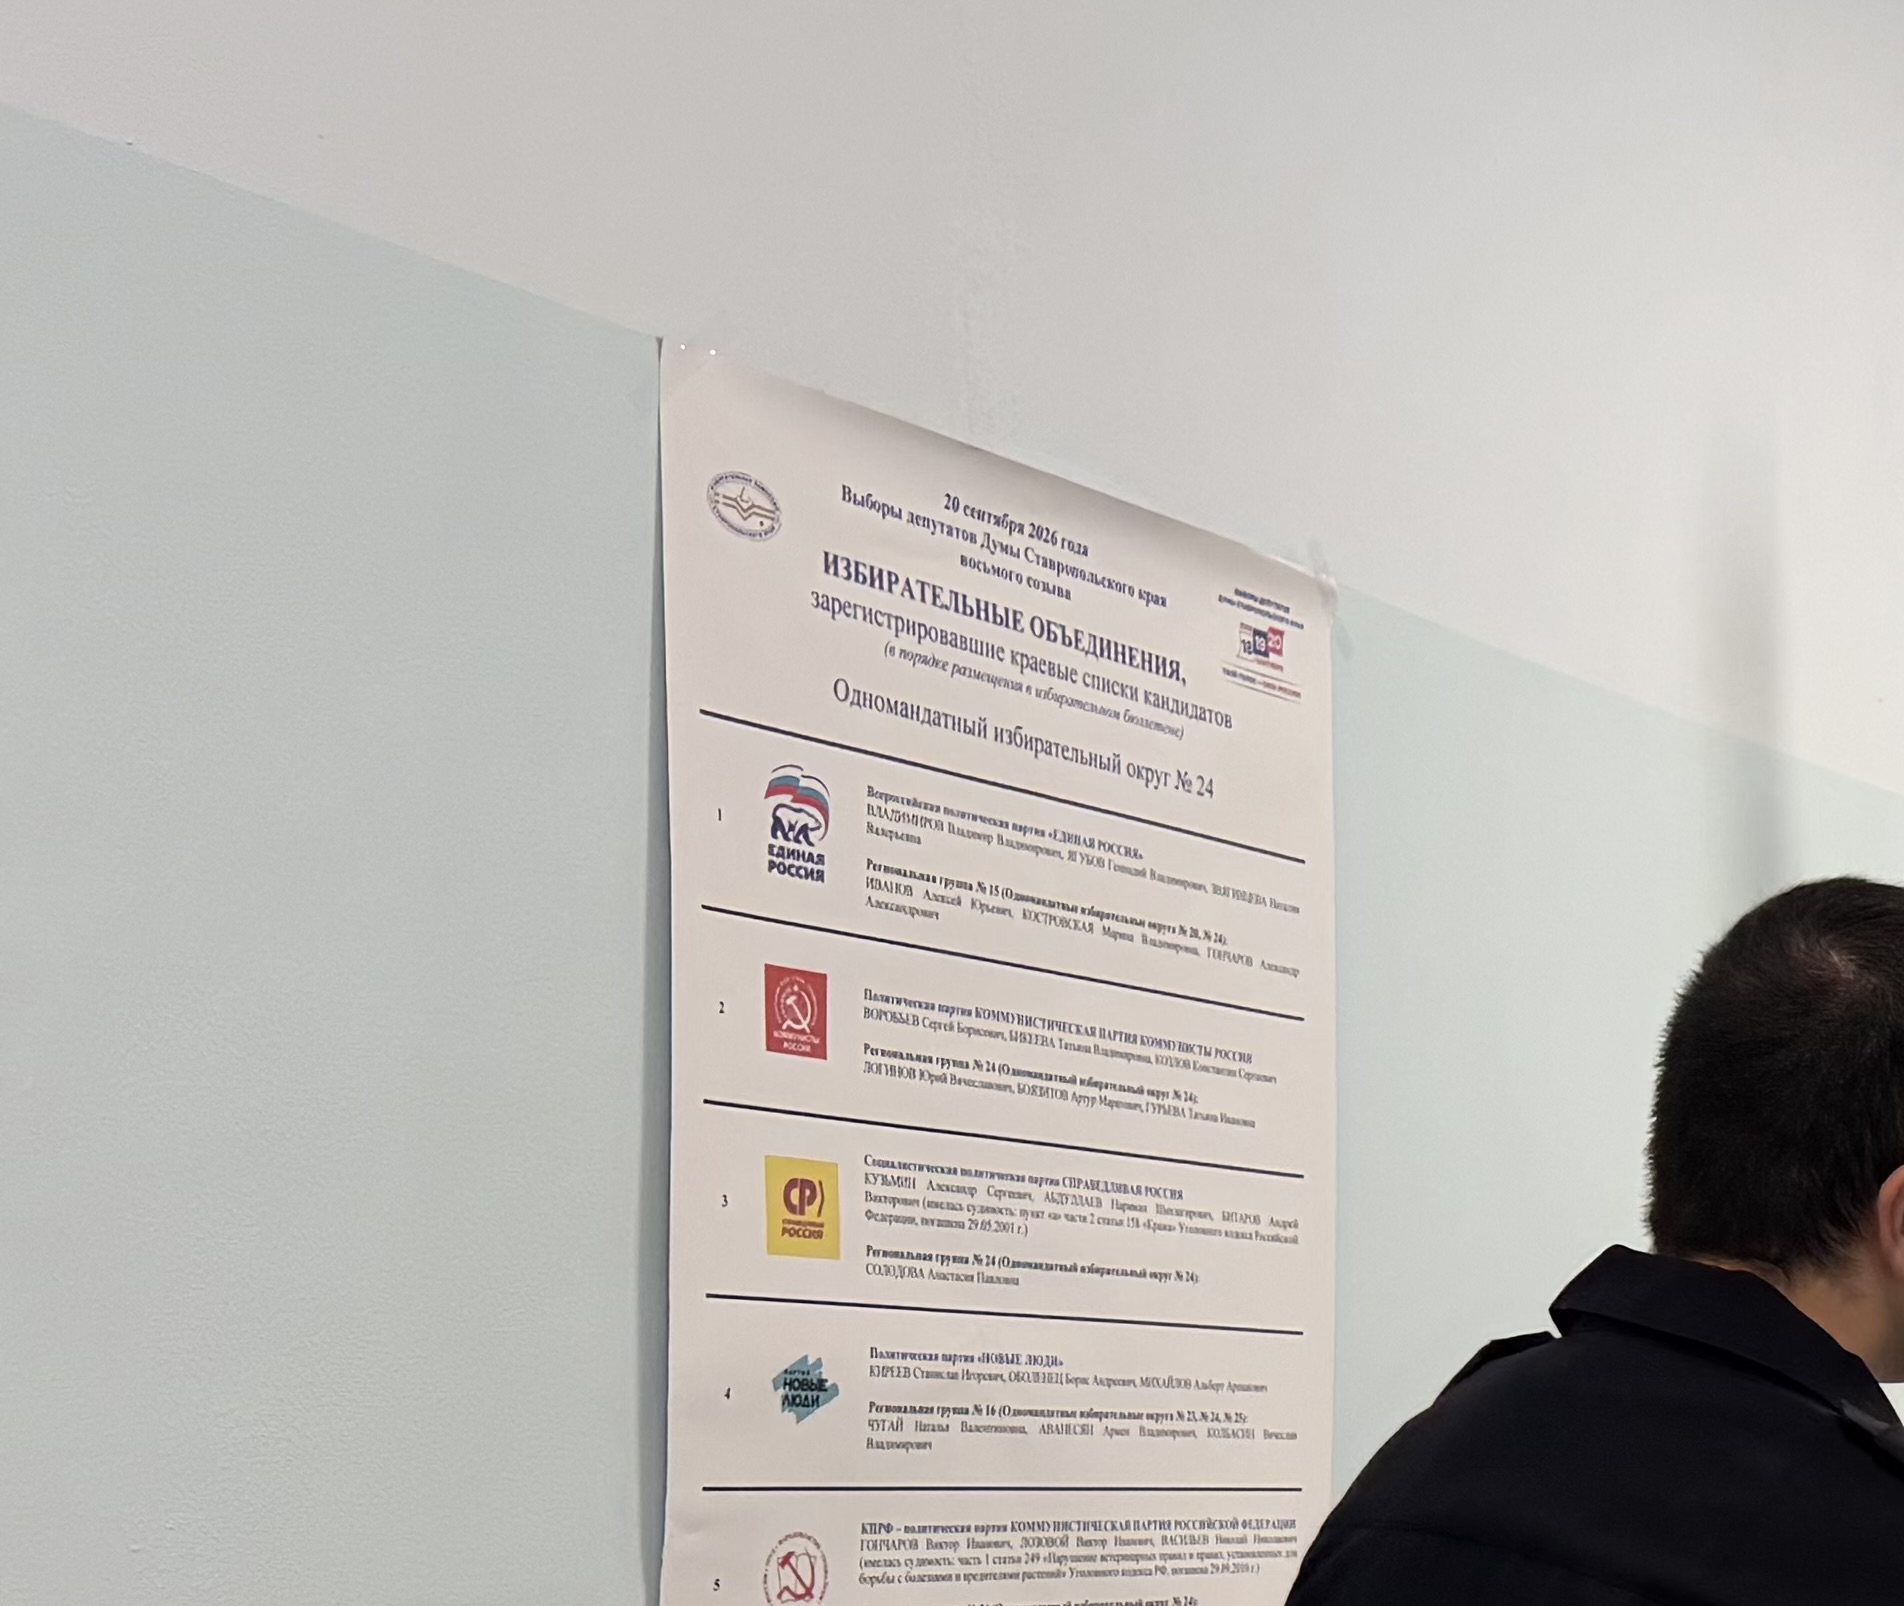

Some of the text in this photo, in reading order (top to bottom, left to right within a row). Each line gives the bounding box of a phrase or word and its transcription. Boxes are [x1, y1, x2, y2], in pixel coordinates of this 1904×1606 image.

[943, 492, 1088, 557] 20 сентября 2026 года
[841, 484, 1167, 607] Выборы депутатов Думы Ставропольского края
[959, 554, 1071, 600] восьмого созыва
[822, 552, 1025, 631] ИЗБИРАТЕЛЬНЫЕ
[1028, 616, 1186, 683] ОБЪЕДИНЕНИЯ,
[810, 592, 1232, 728] зарегистрировавшие краевые списки кандидатов
[897, 647, 949, 671] порядке
[949, 662, 1024, 692] размещения
[832, 679, 1214, 798] Одномандатный избирательный округ № 24
[1010, 822, 1046, 838] партия
[767, 843, 826, 866] ЕДИНАЯ
[767, 859, 826, 883] РОССИЯ
[988, 883, 1000, 897] 15
[718, 1001, 725, 1014] 2
[936, 1003, 973, 1018] партия
[1097, 1026, 1138, 1045] ПАРТИЯ
[984, 1059, 996, 1073] 24
[721, 1194, 729, 1207] 3
[781, 1393, 820, 1408] ЛЮДИ
[860, 1521, 894, 1535] КПРФ
[713, 1578, 721, 1592] 5
